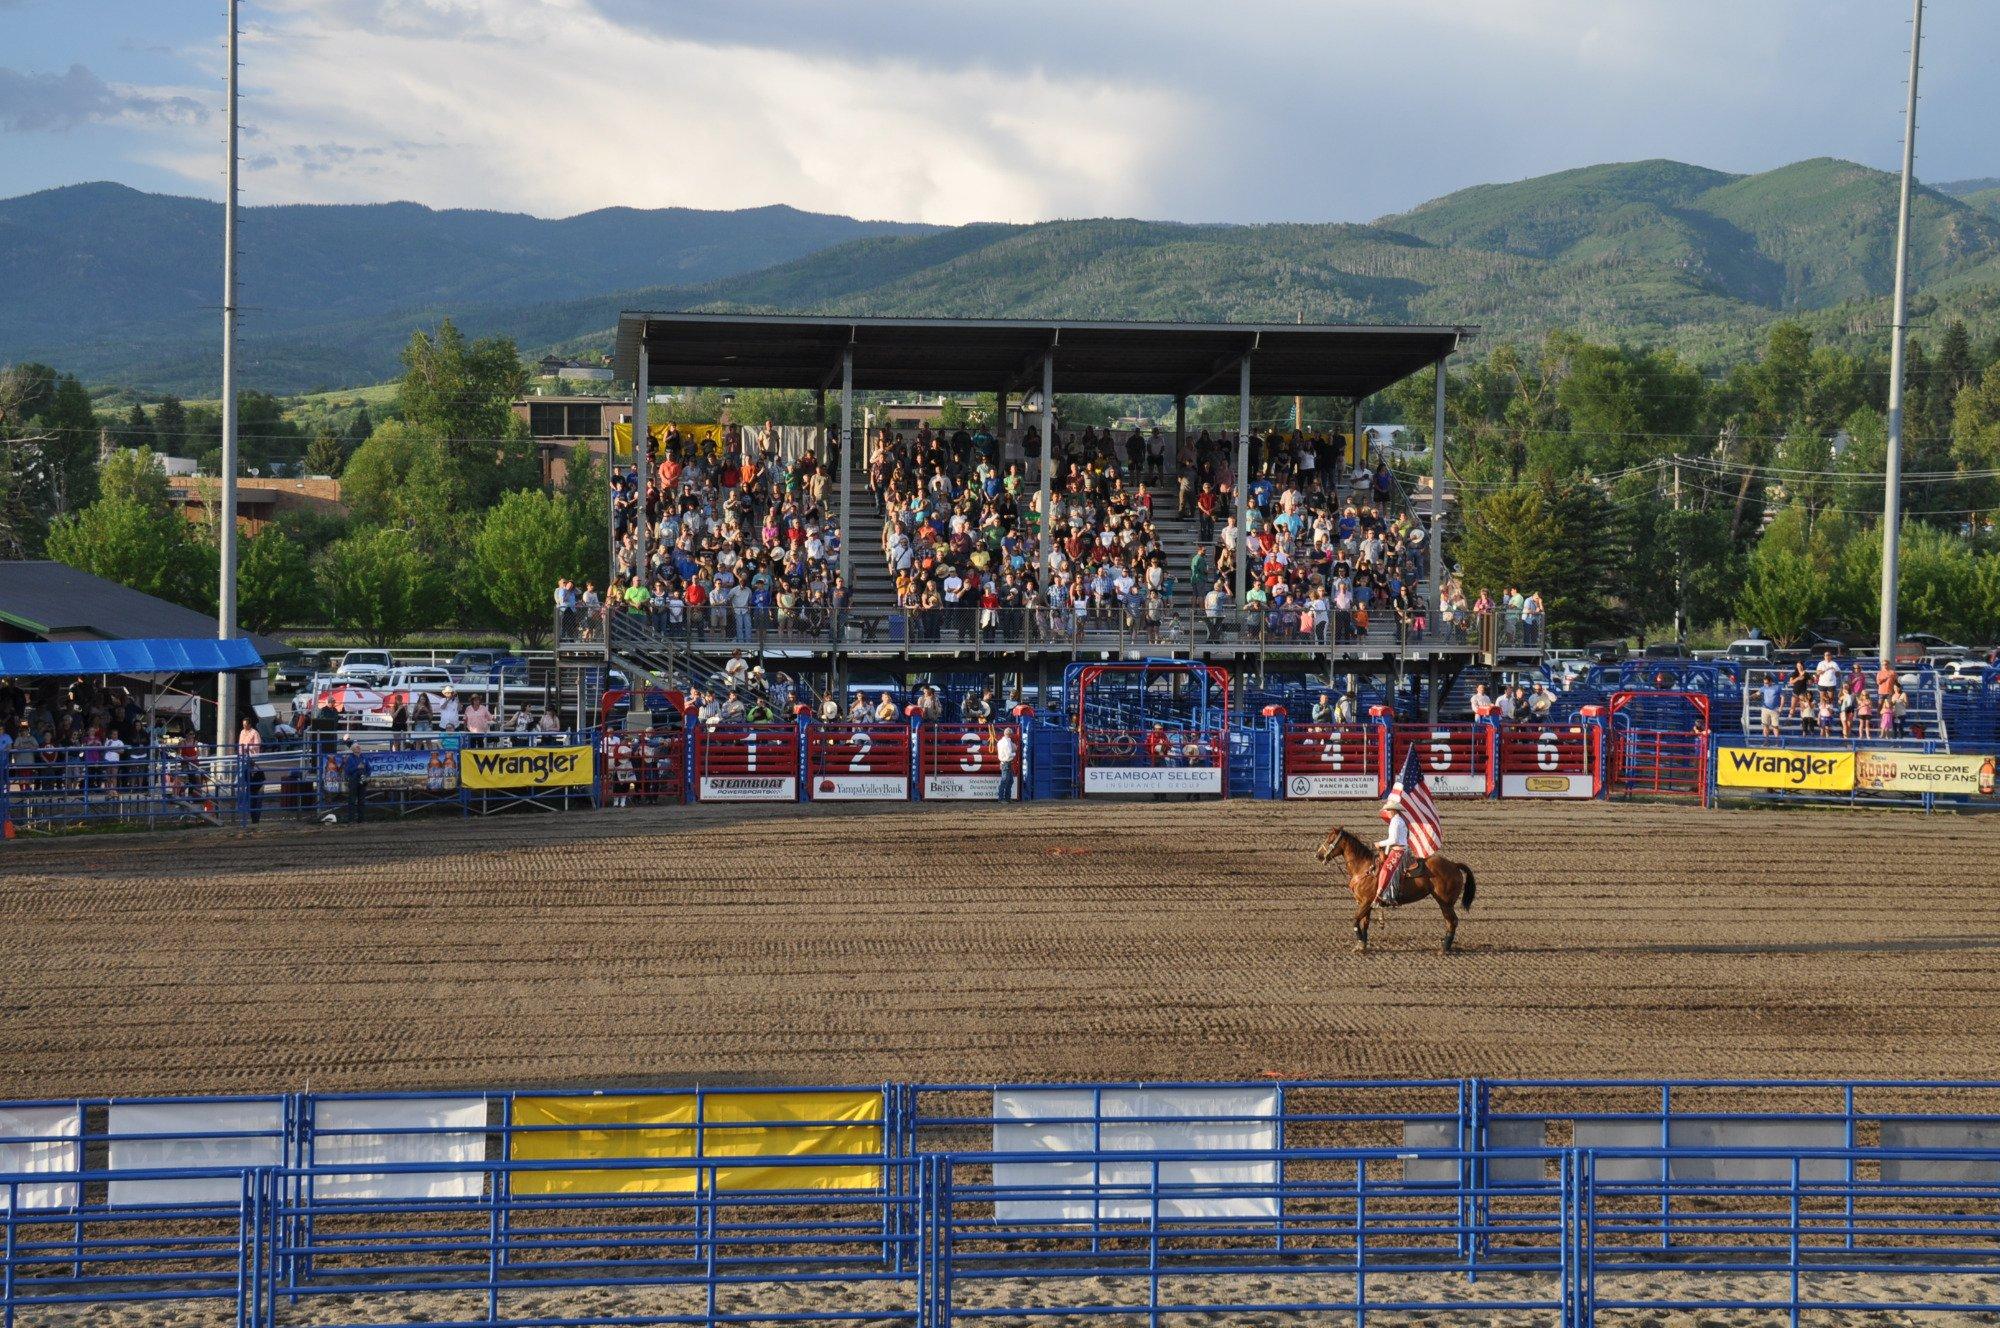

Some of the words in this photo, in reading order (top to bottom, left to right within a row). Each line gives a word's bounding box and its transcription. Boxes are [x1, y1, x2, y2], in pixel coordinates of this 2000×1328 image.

[368, 755, 417, 763] WELCOME
[371, 763, 394, 772] DEO
[396, 762, 425, 771] FANS
[472, 751, 579, 783] Wrangler
[739, 733, 757, 772] 1
[848, 732, 872, 772] 2
[959, 732, 983, 772] 3
[1320, 732, 1345, 771] 4
[1430, 732, 1453, 771] 5
[1537, 732, 1560, 771] 6
[1730, 751, 1838, 784] Wrangler
[709, 779, 786, 789] STEAMBOAT
[1090, 771, 1165, 781] STEAMBOAT
[1167, 771, 1216, 781] SELECT
[1900, 773, 1941, 781] RODEO
[1944, 774, 1978, 783] FANS
[1908, 764, 1970, 774] WELCOME
[929, 782, 965, 792] BRISTOL
